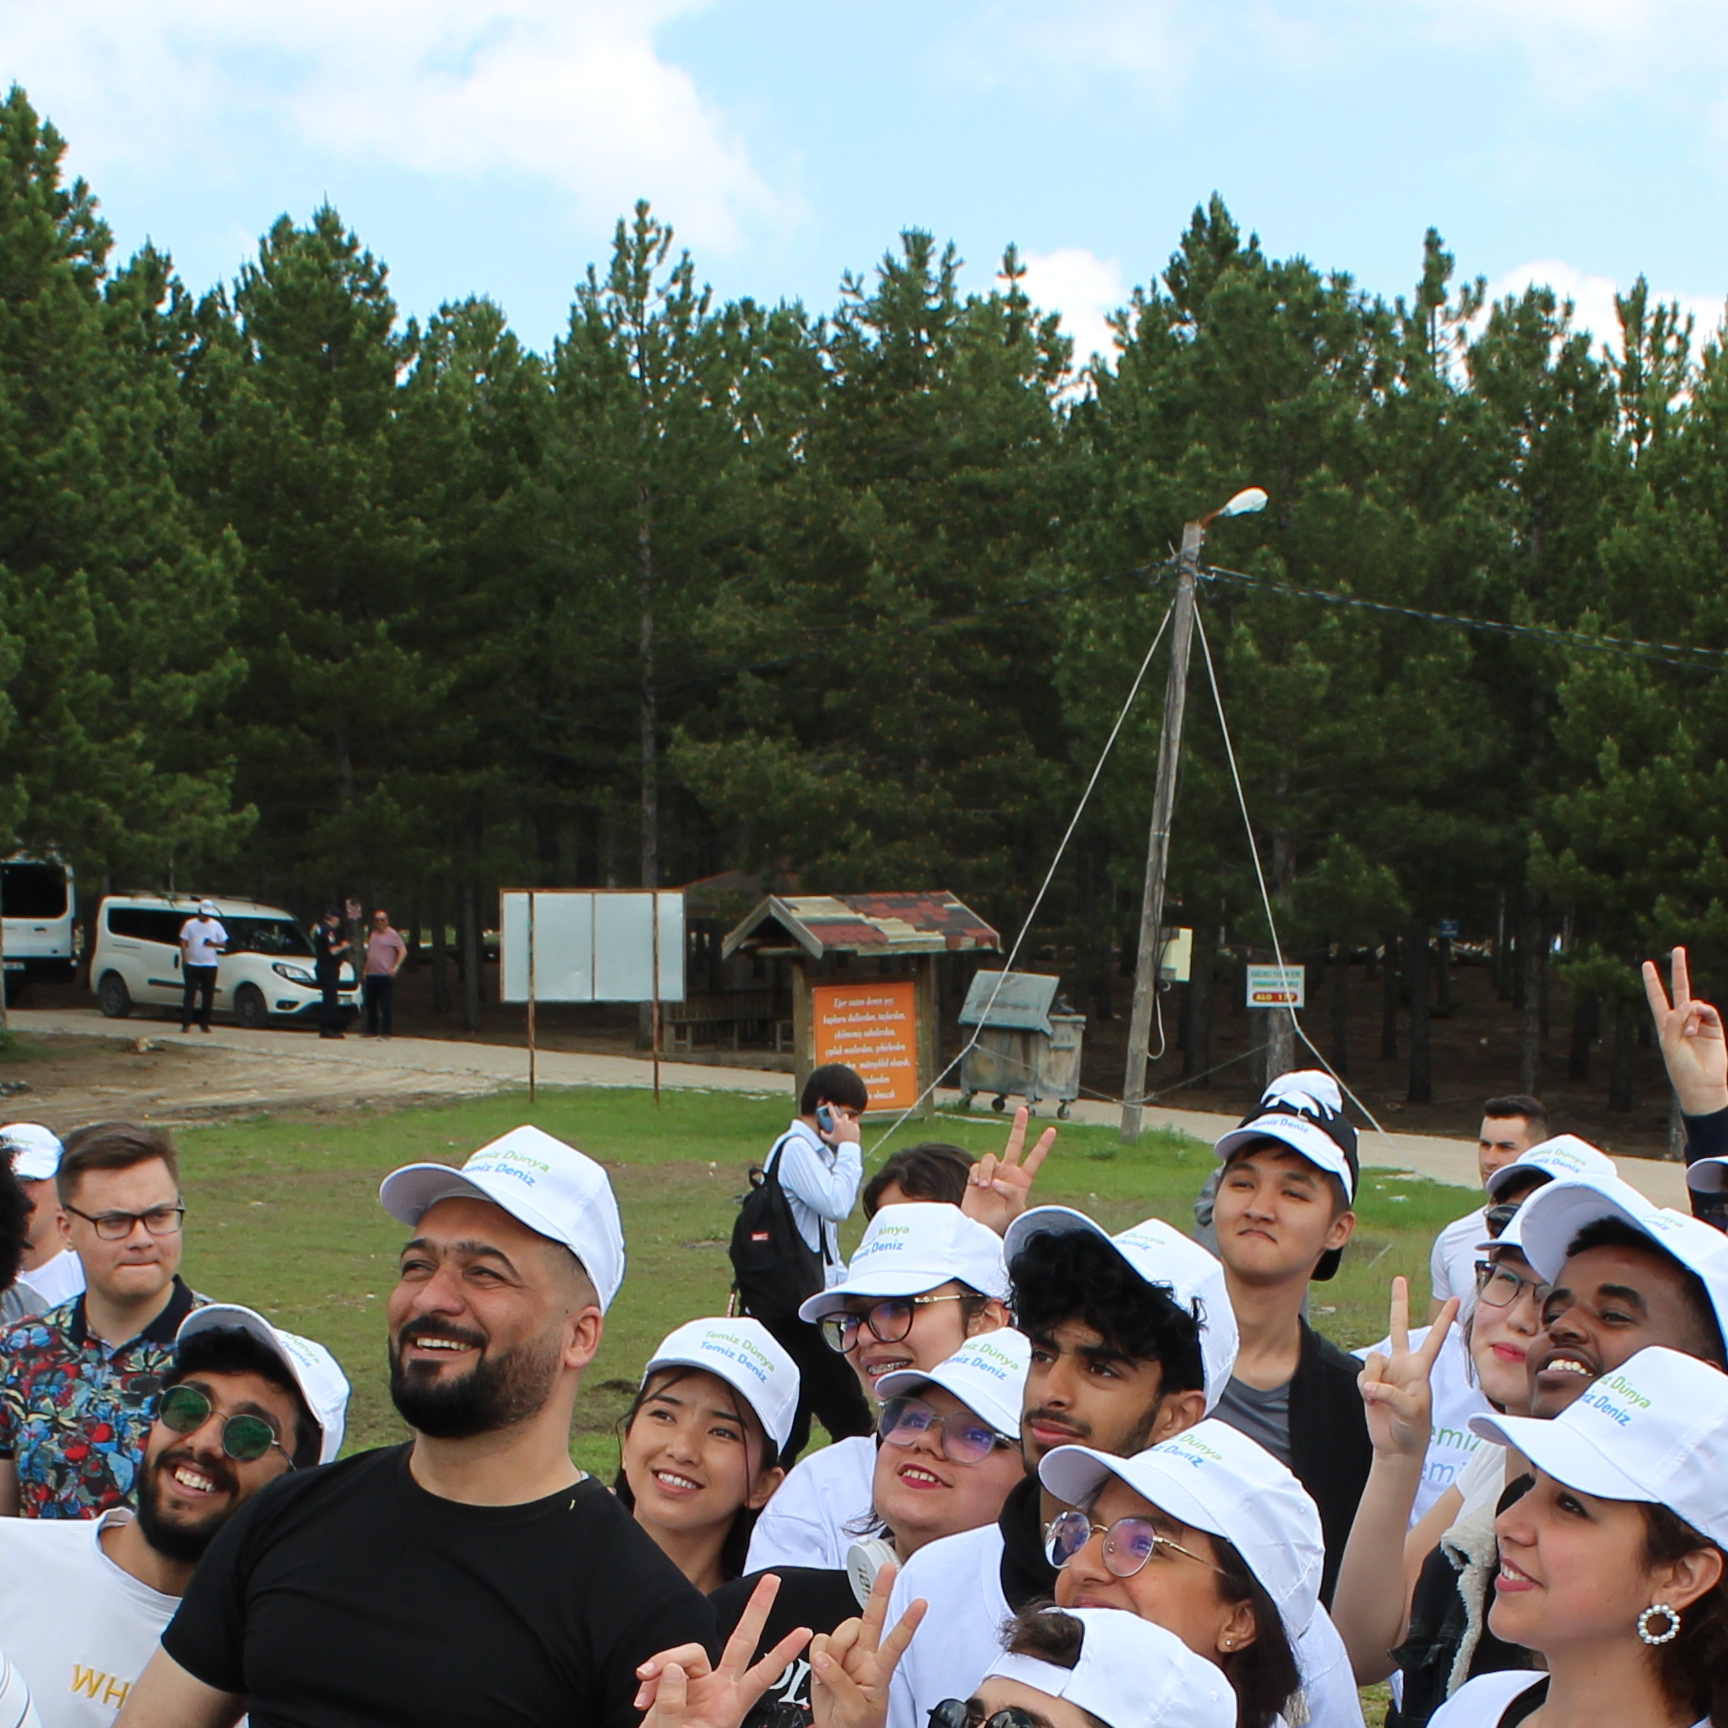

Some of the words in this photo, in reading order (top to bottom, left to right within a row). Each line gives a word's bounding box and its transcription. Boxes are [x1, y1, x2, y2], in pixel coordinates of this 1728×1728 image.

[1280, 1117, 1310, 1135] Deniz
[503, 1150, 551, 1173] Dünya
[494, 1163, 536, 1188] Deniz
[878, 1225, 910, 1236] ünya
[871, 1239, 904, 1254] Deniz
[700, 1340, 736, 1360] Temiz
[737, 1353, 768, 1385] Deniz
[706, 1330, 741, 1346] Temiz
[741, 1339, 776, 1373] Dünya
[979, 1343, 1019, 1371] Dünya
[970, 1356, 1008, 1381] Deniz
[1610, 1375, 1652, 1410] Dünya
[1593, 1395, 1632, 1428] Deniz
[1163, 1444, 1204, 1469] Deniz
[1178, 1433, 1223, 1461] Dünya
